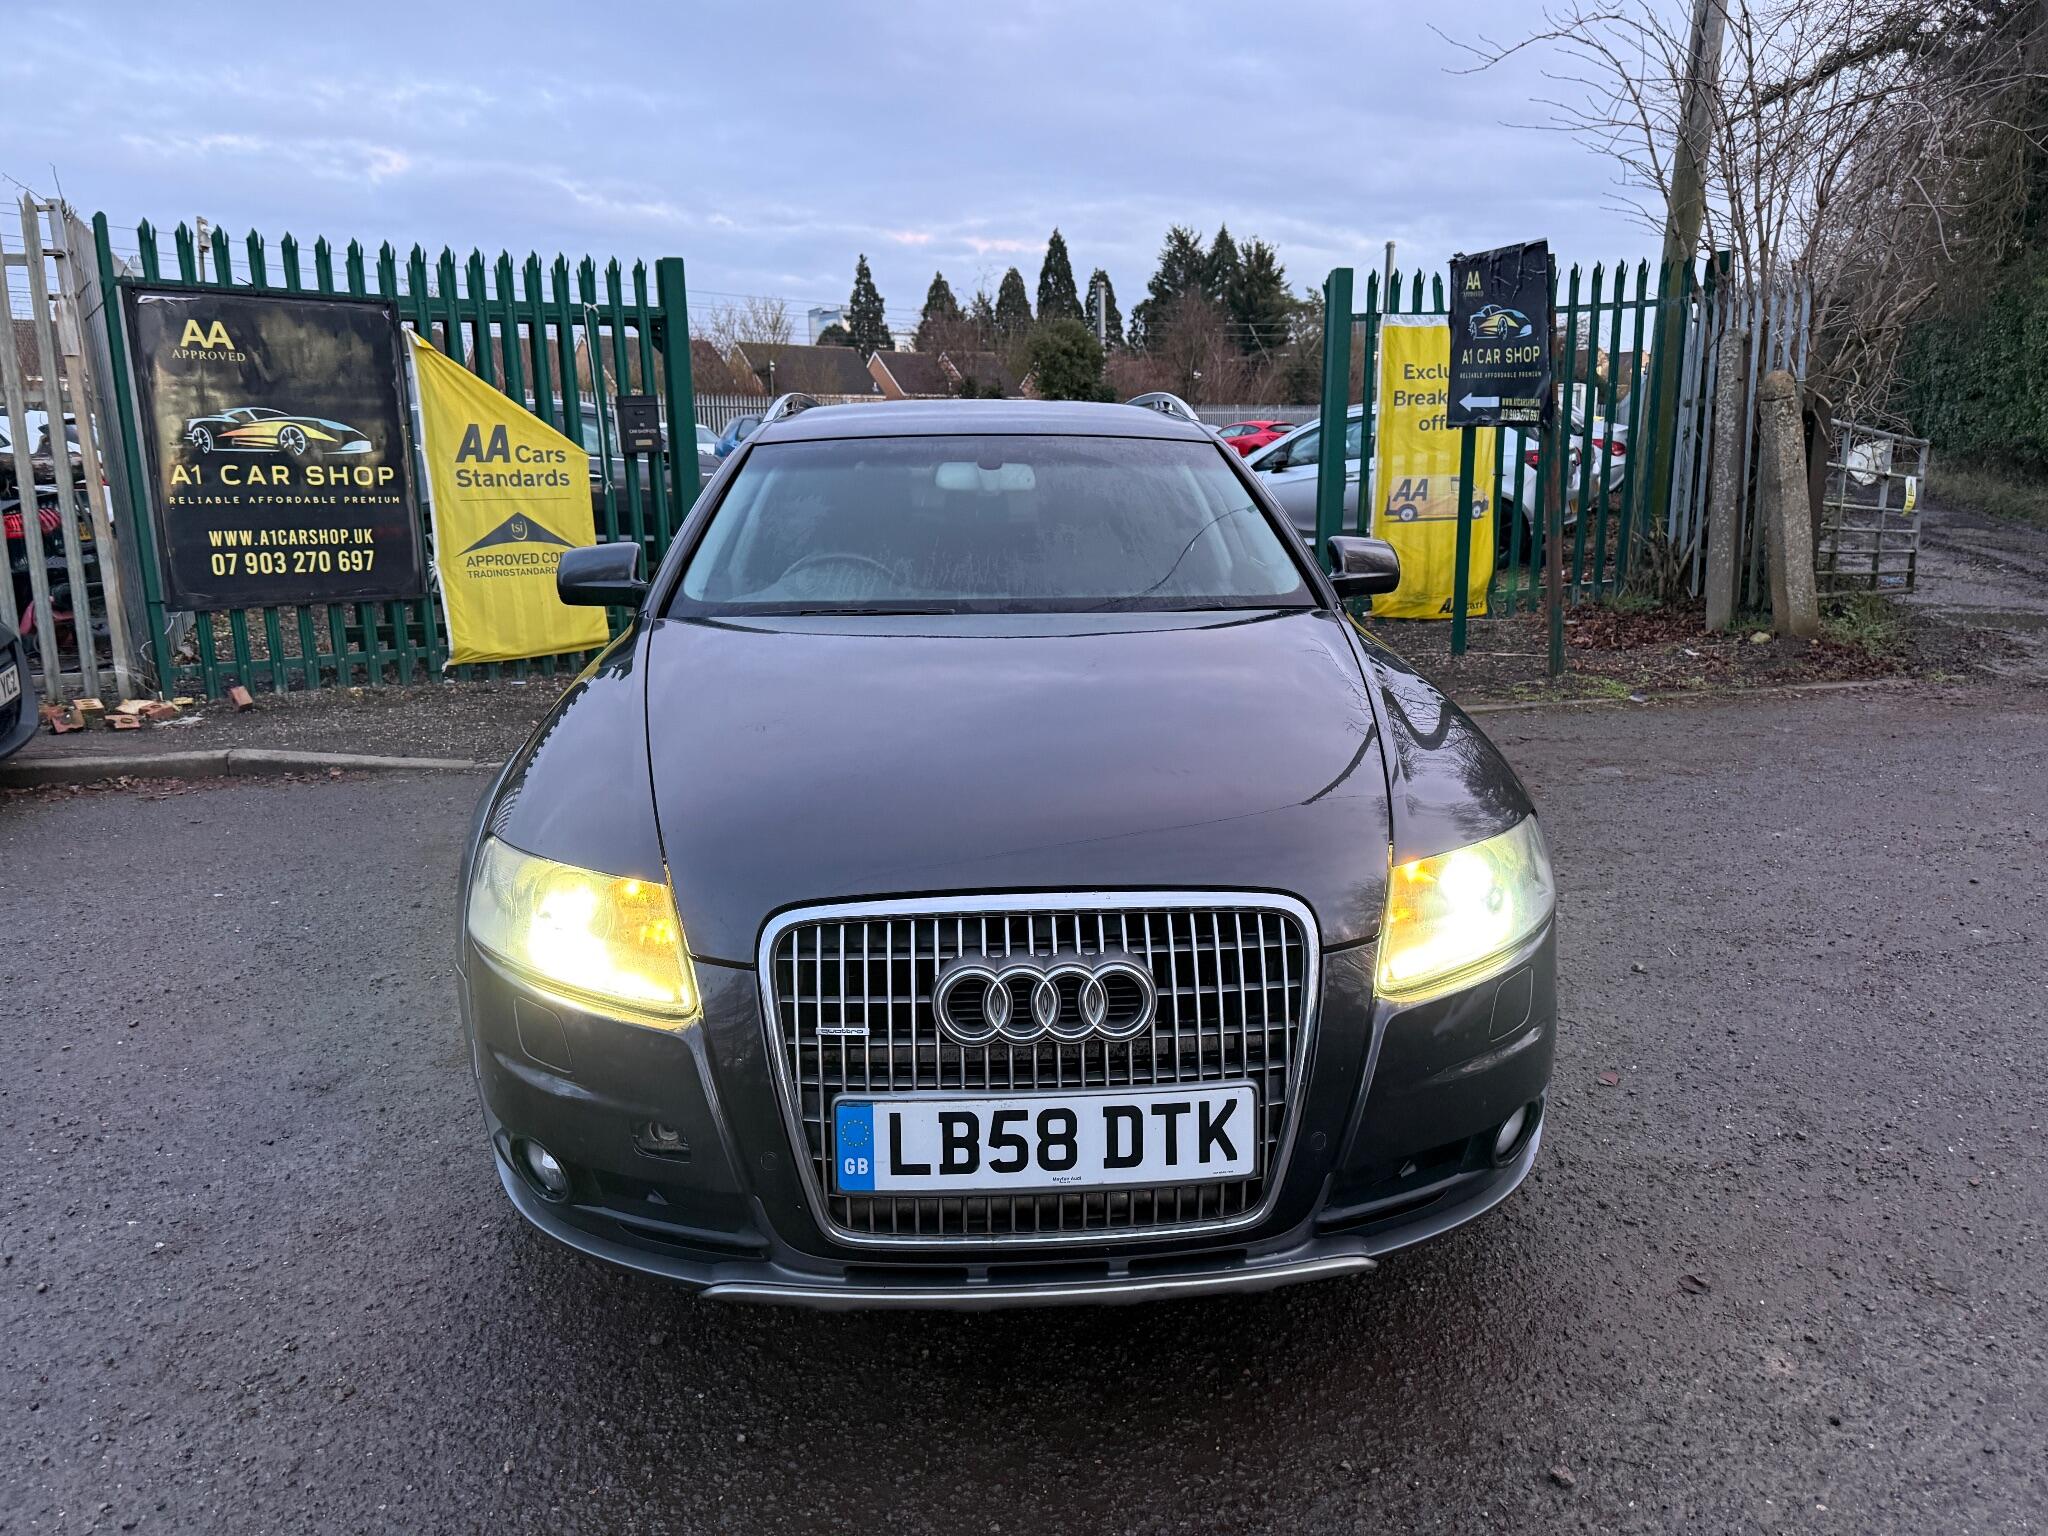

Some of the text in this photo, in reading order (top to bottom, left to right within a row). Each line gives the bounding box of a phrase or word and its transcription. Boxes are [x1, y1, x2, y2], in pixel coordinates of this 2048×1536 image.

[1466, 271, 1481, 290] AA
[180, 319, 235, 350] AA
[172, 349, 246, 361] APPROVED
[1462, 346, 1540, 364] A1 CAR SHOP
[455, 424, 566, 463] AA Cars
[170, 464, 395, 486] A1 CAR SHOP
[456, 469, 570, 487] Standards
[1392, 479, 1428, 501] AA
[169, 496, 400, 505] RELIABLE AFFORDABLE PREMIUM
[208, 528, 374, 547] WWW.A1CARSHOP.UK
[211, 550, 375, 576] 07 903 270 697
[466, 553, 540, 567] APPROVED
[889, 1099, 1238, 1176] LB58 DTK
[844, 1157, 868, 1175] GB
